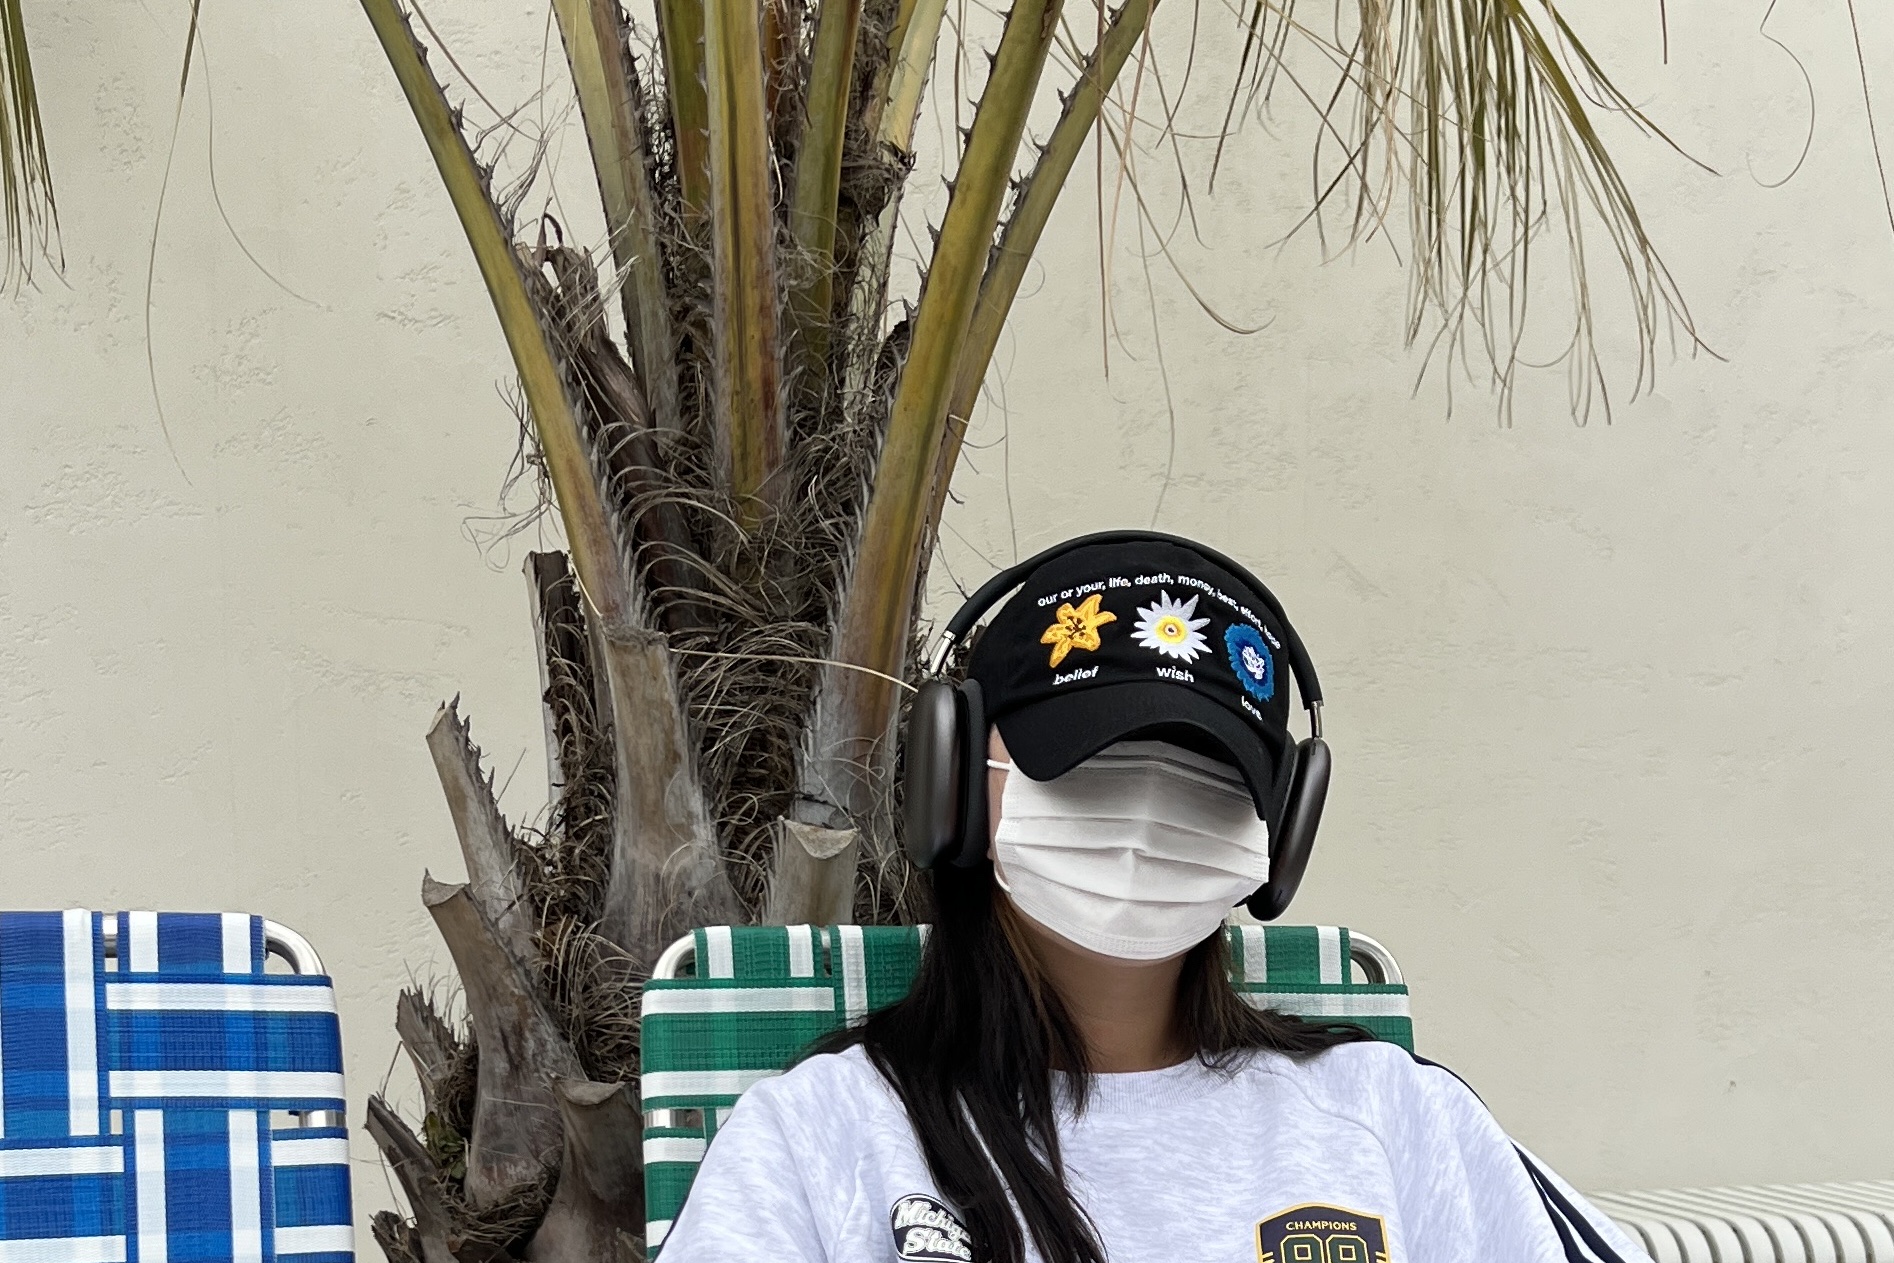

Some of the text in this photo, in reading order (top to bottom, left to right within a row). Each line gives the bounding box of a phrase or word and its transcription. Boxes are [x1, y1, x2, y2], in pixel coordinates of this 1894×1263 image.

[1037, 593, 1058, 607] our
[1060, 588, 1074, 599] or
[1075, 581, 1106, 598] your,
[1108, 576, 1132, 588] life,
[1134, 573, 1174, 586] death,
[1177, 575, 1216, 597] money,
[1052, 665, 1099, 686] belief
[1156, 665, 1195, 683] wish
[1241, 695, 1264, 721] love
[1285, 1220, 1358, 1231] CHAMPIONS
